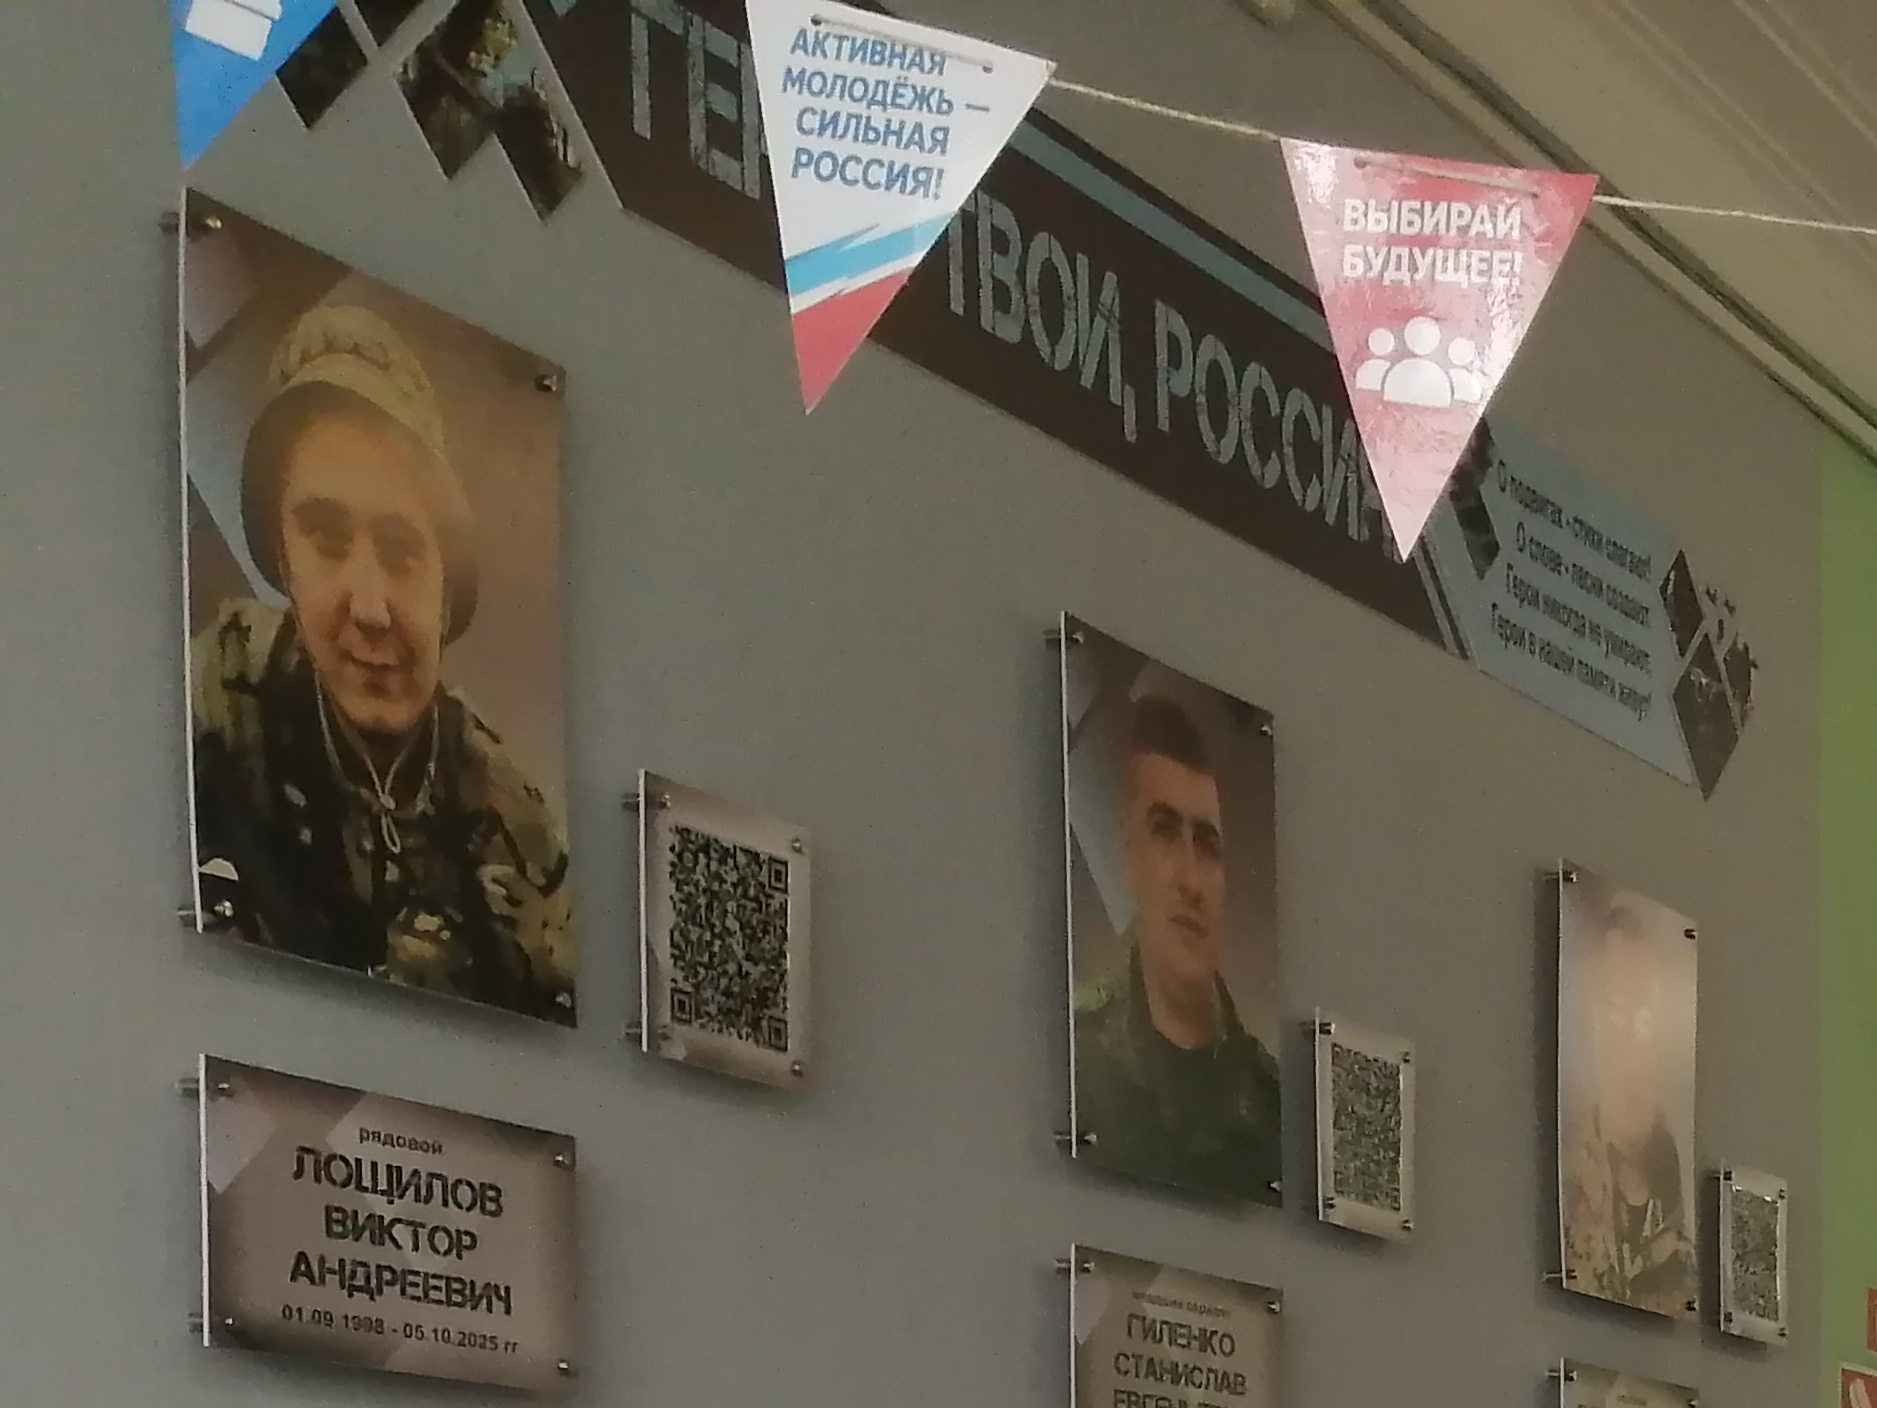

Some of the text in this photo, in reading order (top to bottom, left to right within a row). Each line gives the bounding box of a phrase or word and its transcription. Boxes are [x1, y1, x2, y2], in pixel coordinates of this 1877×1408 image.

[790, 28, 947, 77] АКТИВНАЯ
[782, 66, 955, 116] МОЛОДЁЖЬ
[795, 106, 951, 155] СИЛЬНАЯ
[791, 148, 944, 200] РОССИЯ!
[1343, 197, 1522, 240] ВЫБИРАЙ
[1342, 244, 1524, 288] БУДУЩЕЕ!
[1154, 298, 1403, 563] РОССИ
[359, 1126, 443, 1156] рядовой
[292, 1145, 505, 1218] ЛОЩИЛОВ
[324, 1204, 478, 1260] ВИКТОР
[289, 1250, 513, 1316] АНДРЕЕВИЧ
[1113, 1352, 1248, 1397] СТАНИСЛАВ
